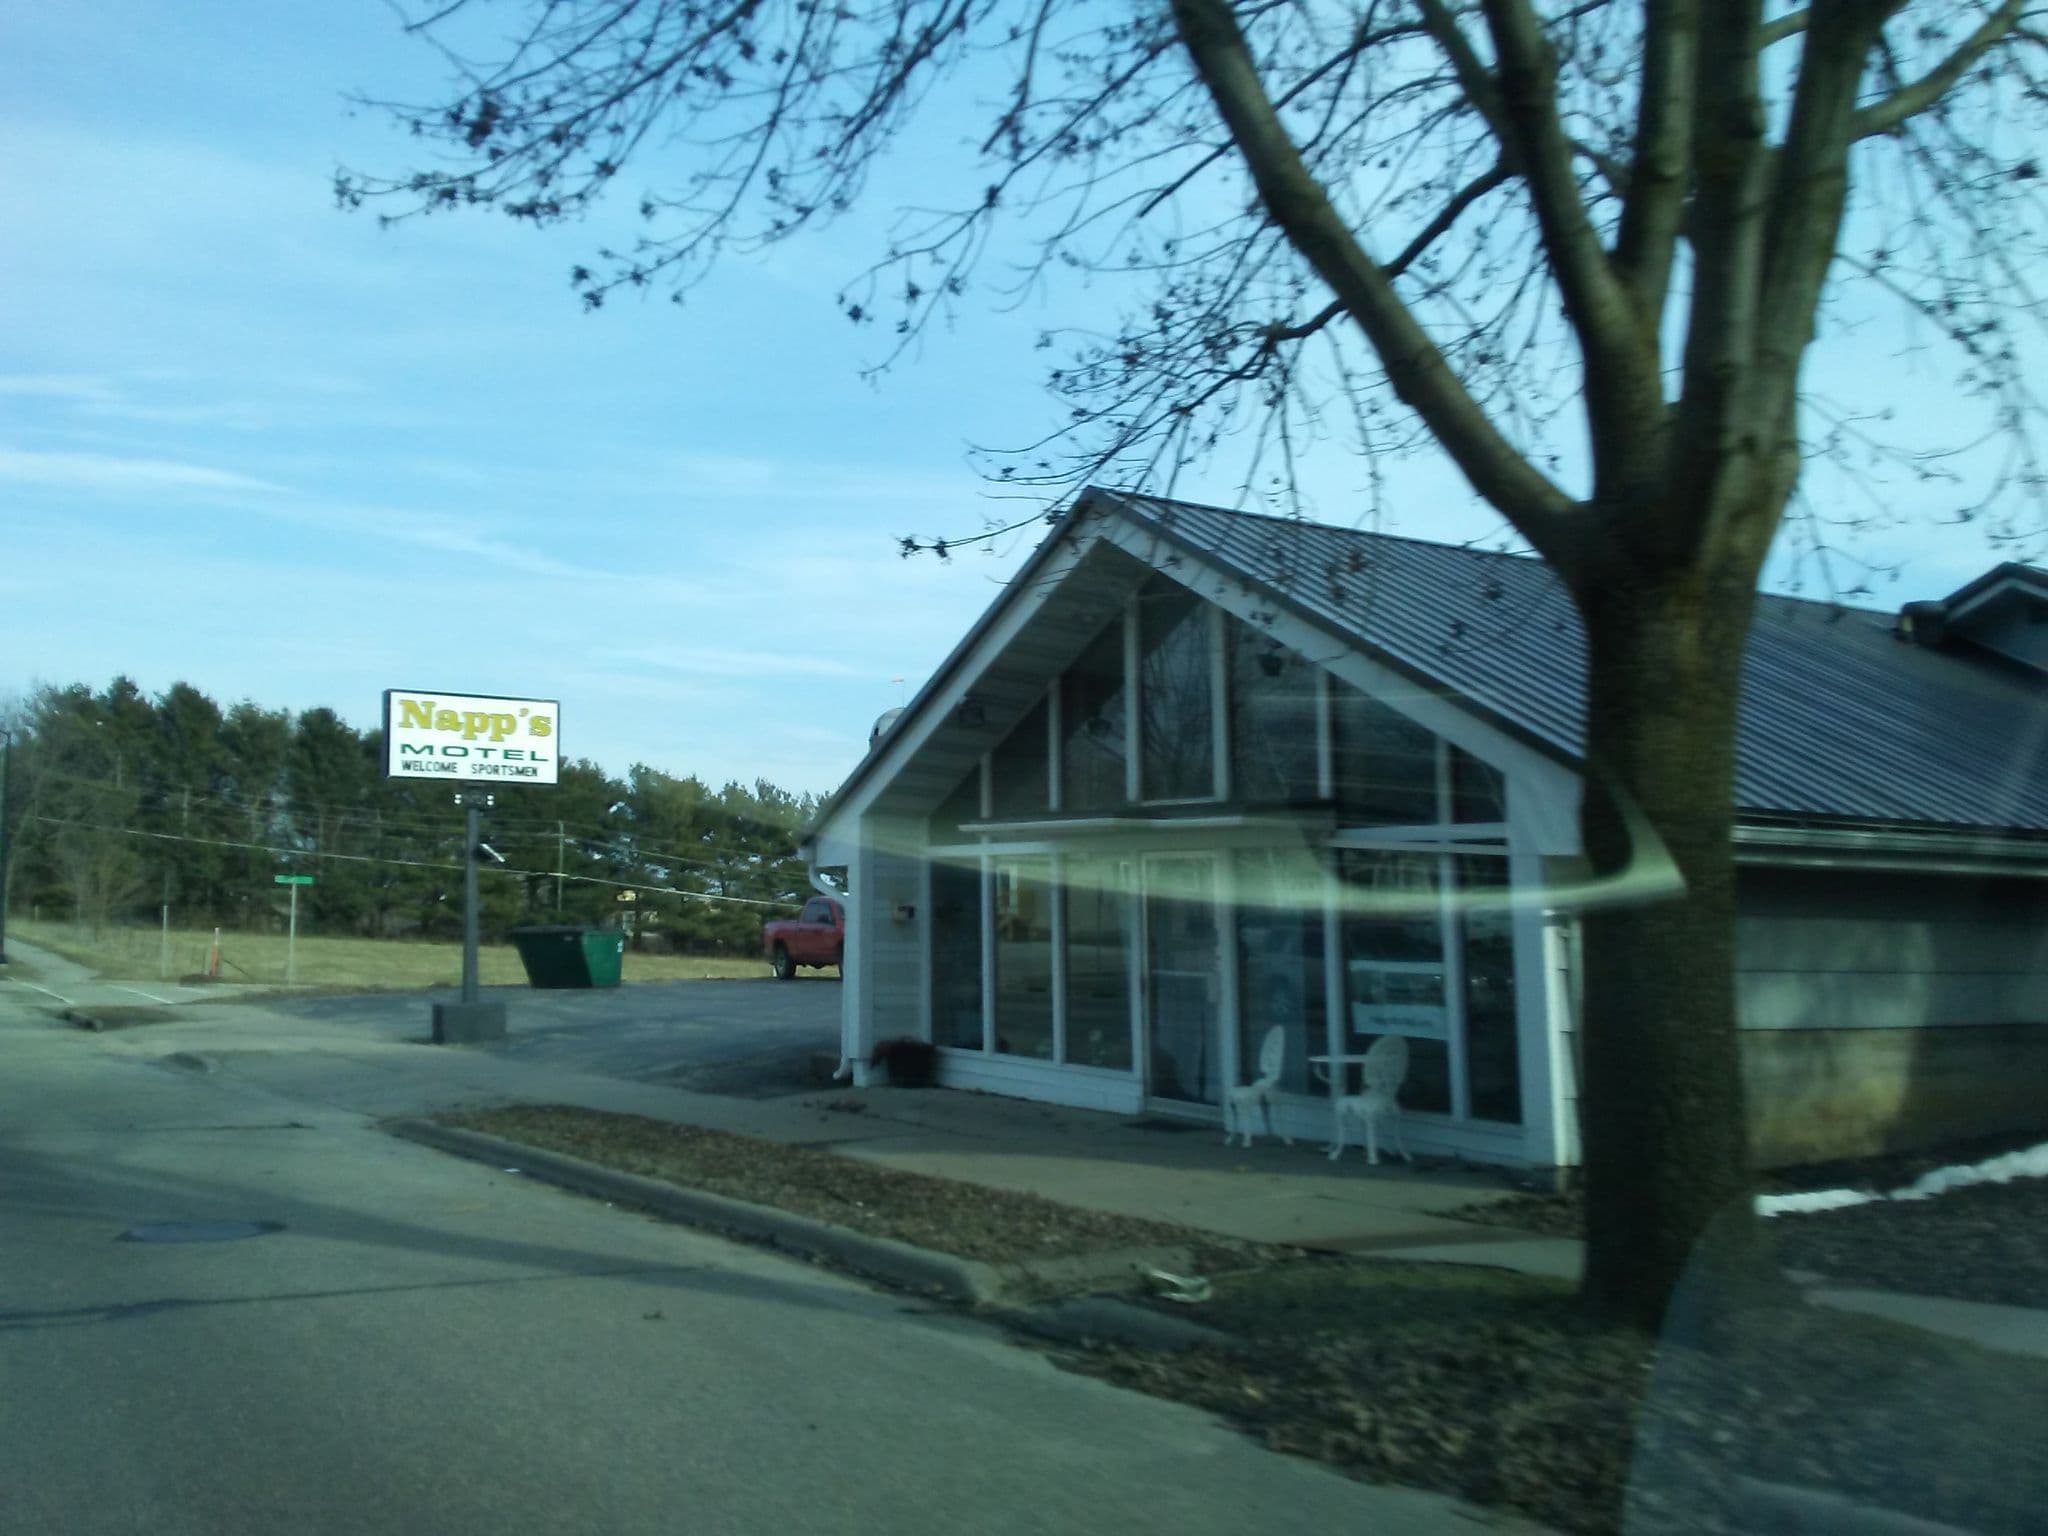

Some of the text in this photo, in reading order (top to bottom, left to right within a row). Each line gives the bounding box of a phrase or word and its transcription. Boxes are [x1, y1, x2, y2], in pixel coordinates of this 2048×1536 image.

[399, 699, 552, 742] Napp's
[400, 743, 549, 762] MOTEL
[401, 760, 538, 777] WELCOME SPORTSMEN
